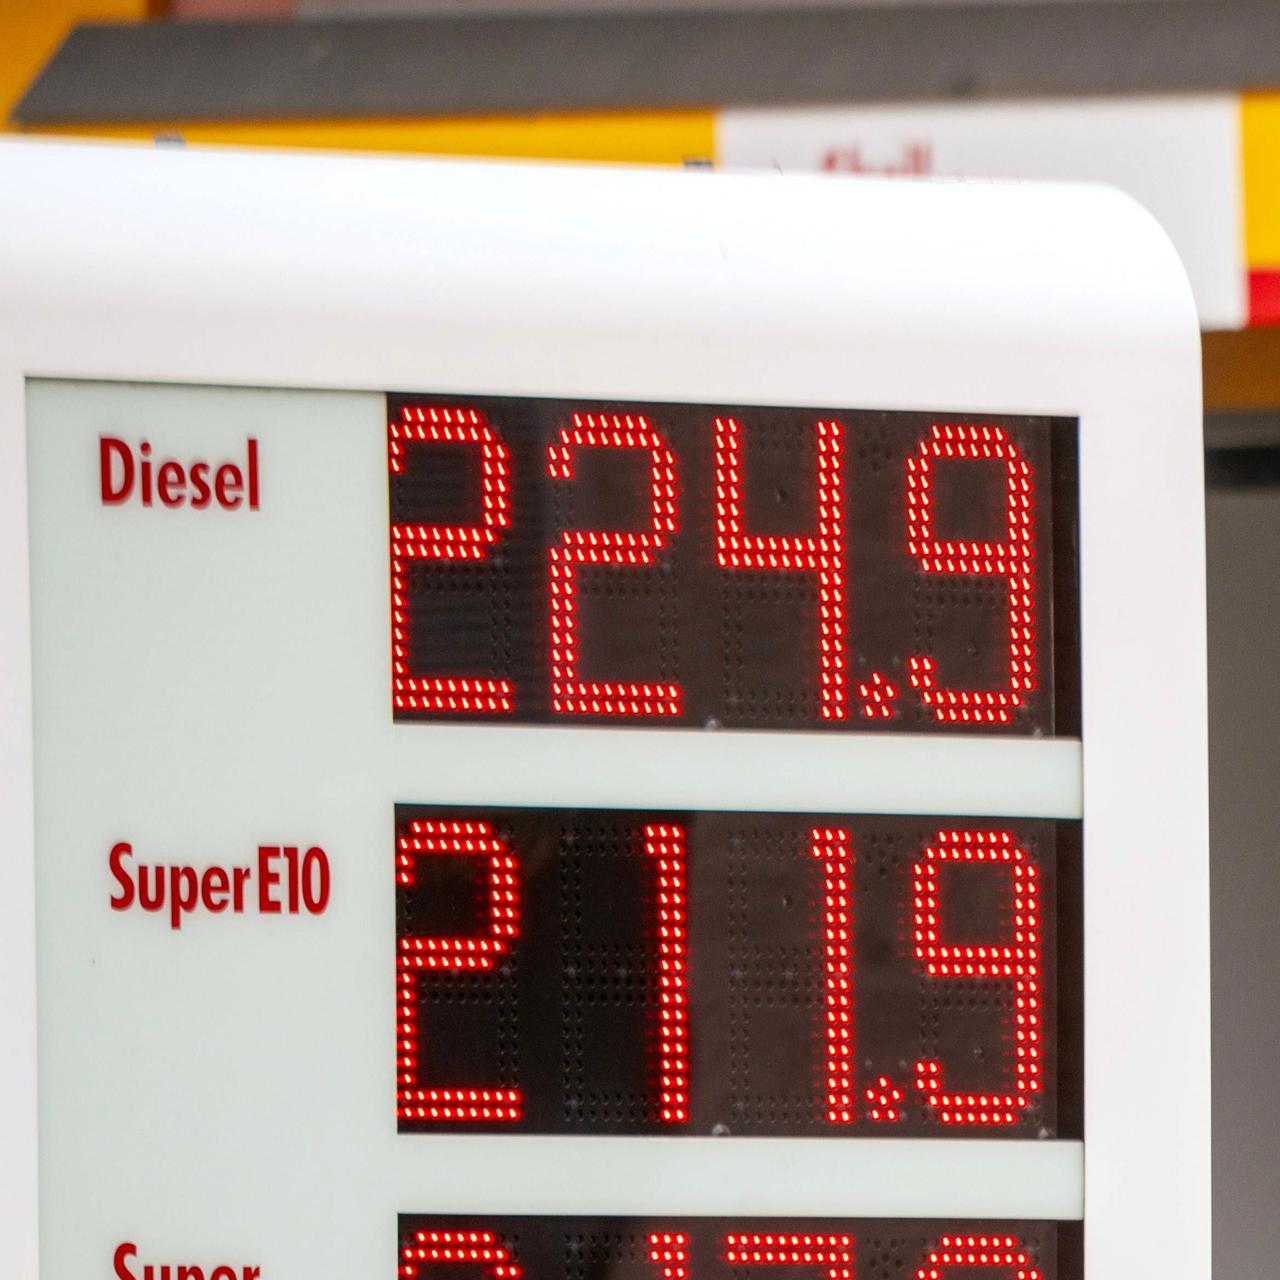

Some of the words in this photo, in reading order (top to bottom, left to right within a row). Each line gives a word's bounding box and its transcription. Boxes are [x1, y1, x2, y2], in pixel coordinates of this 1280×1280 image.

[99, 437, 259, 510] Diesel
[389, 405, 1037, 724] 224.9
[397, 819, 1043, 1126] 211.9
